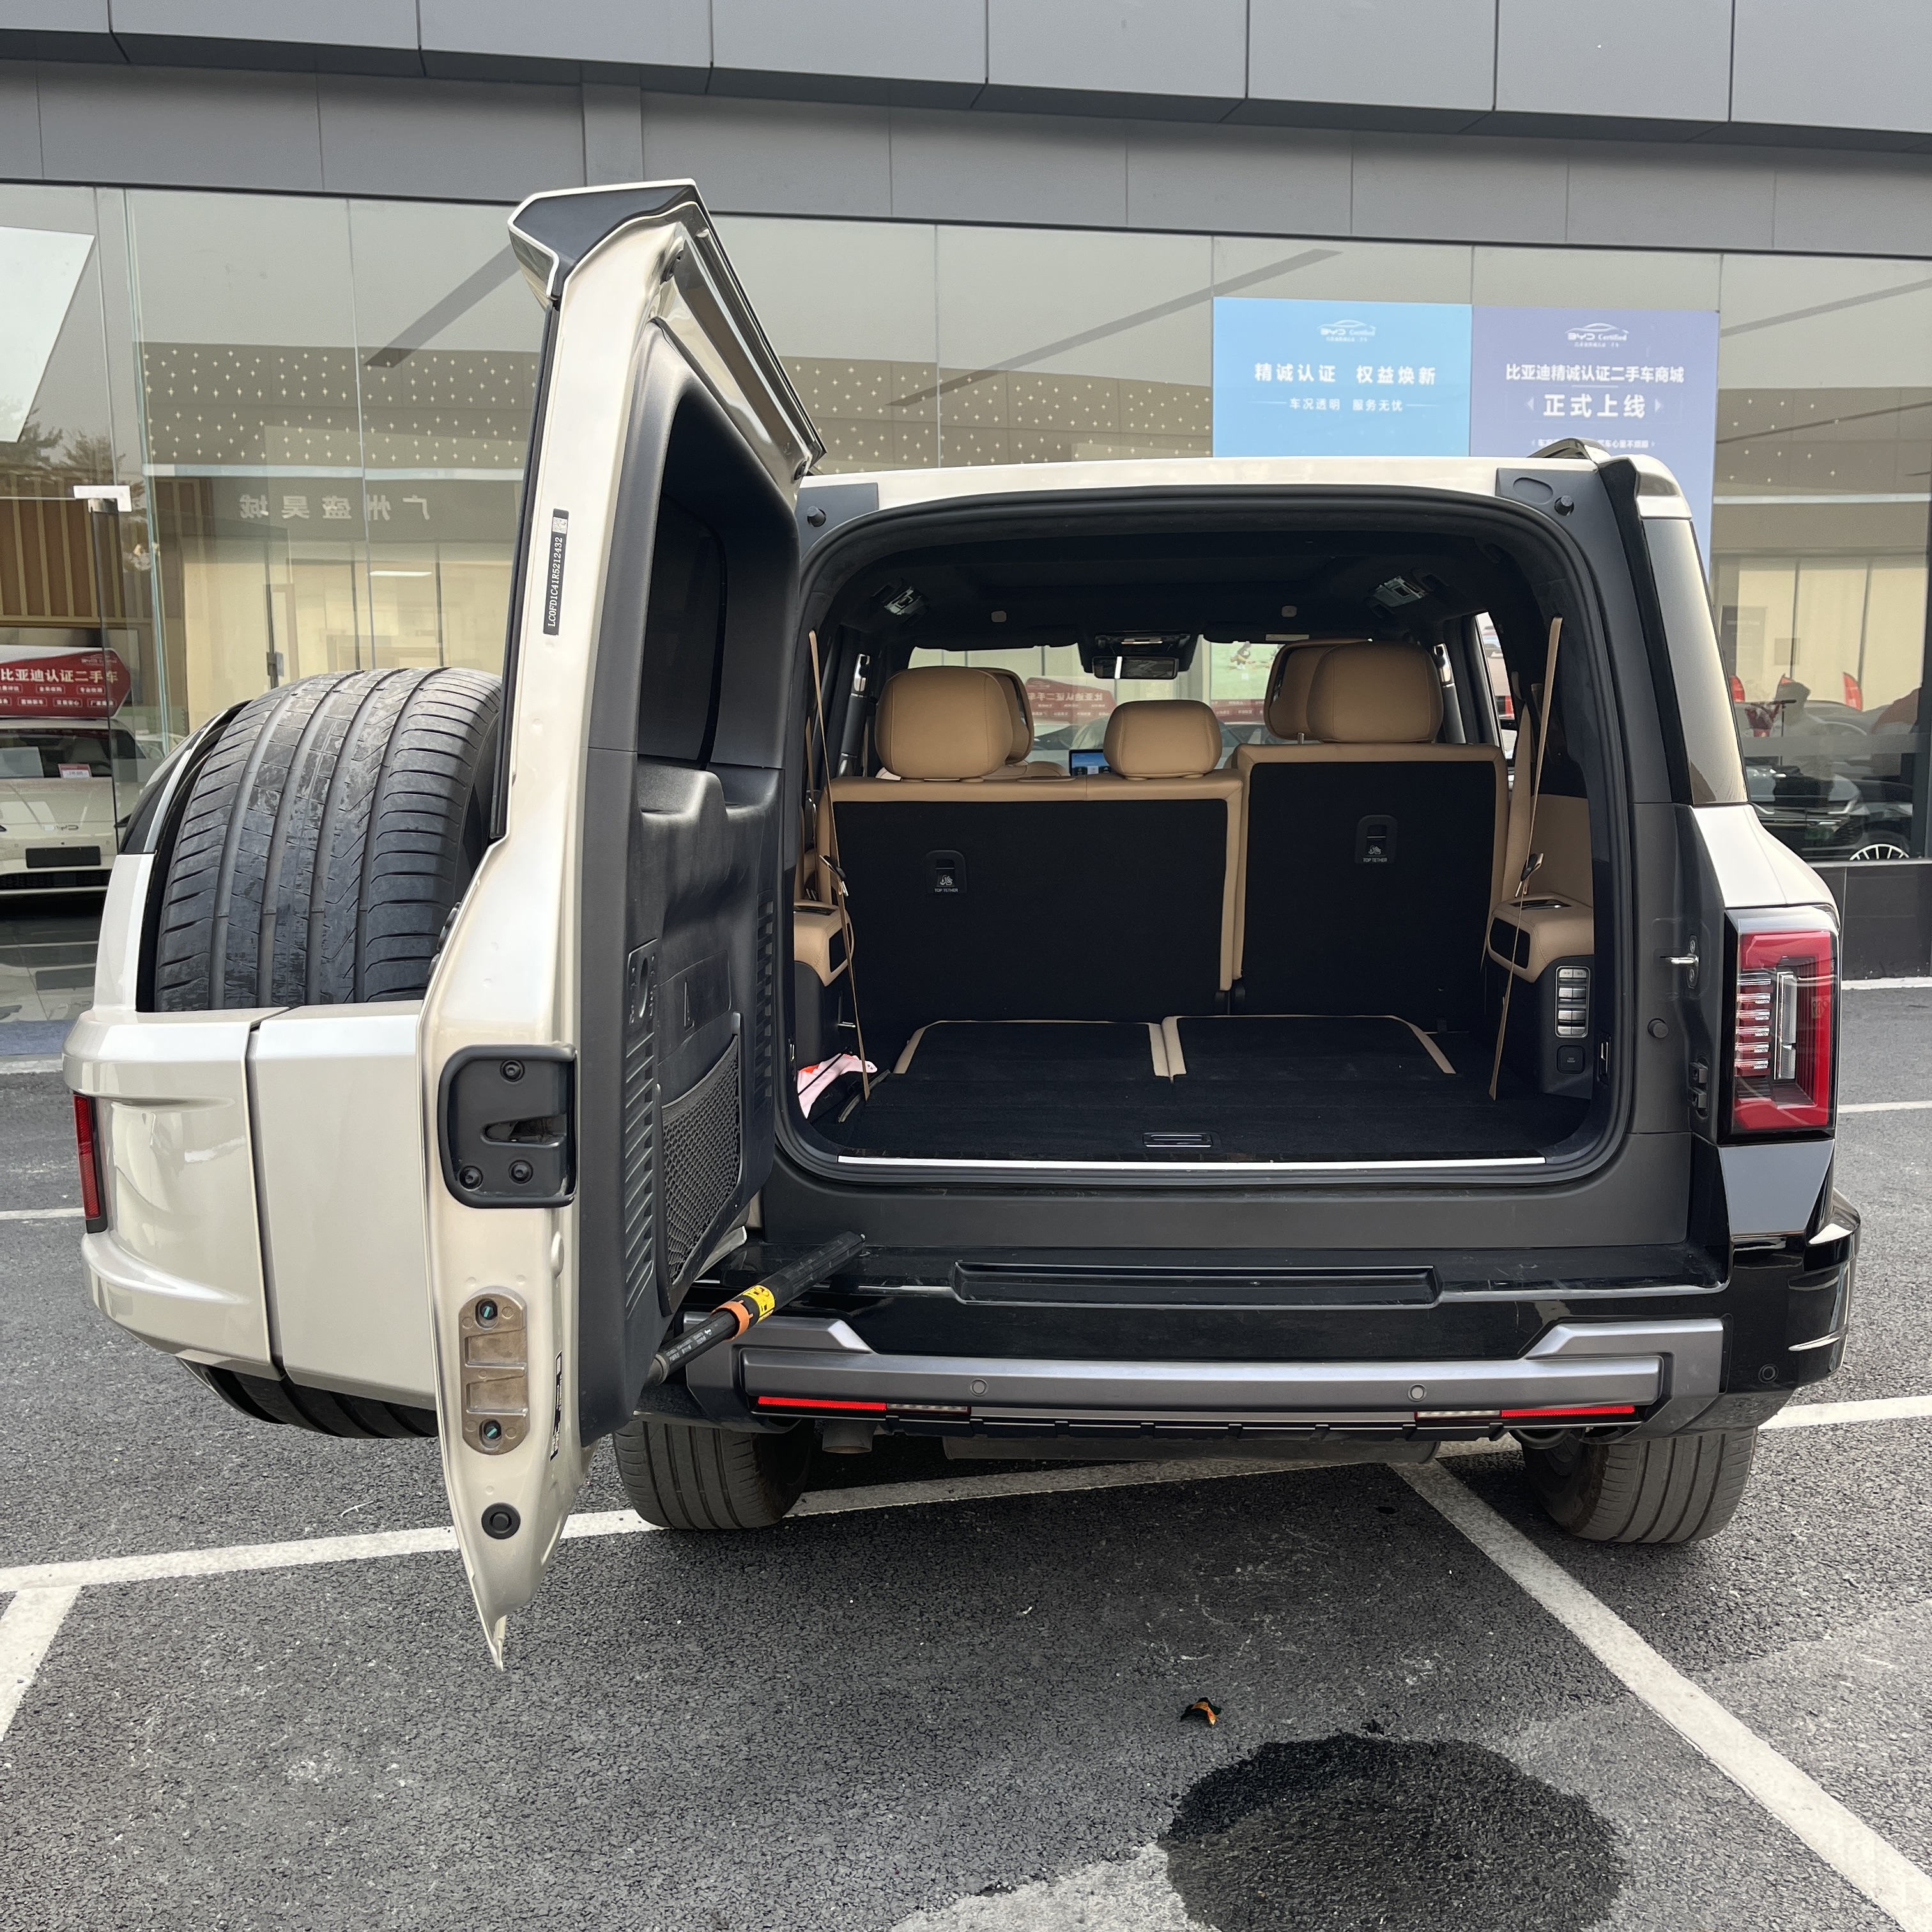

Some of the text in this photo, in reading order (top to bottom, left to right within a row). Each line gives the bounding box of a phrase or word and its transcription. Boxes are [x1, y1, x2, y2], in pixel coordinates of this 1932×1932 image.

[1567, 332, 1595, 341] BYD
[1255, 363, 1436, 385] 精诚认证 权益焕新
[1505, 364, 1685, 383] 比亚迪精诚认证二手车商城
[1289, 397, 1403, 411] 车况透明 服务无忧
[1543, 394, 1646, 418] 正式上线
[1, 668, 118, 684] 比亚迪认证二手车
